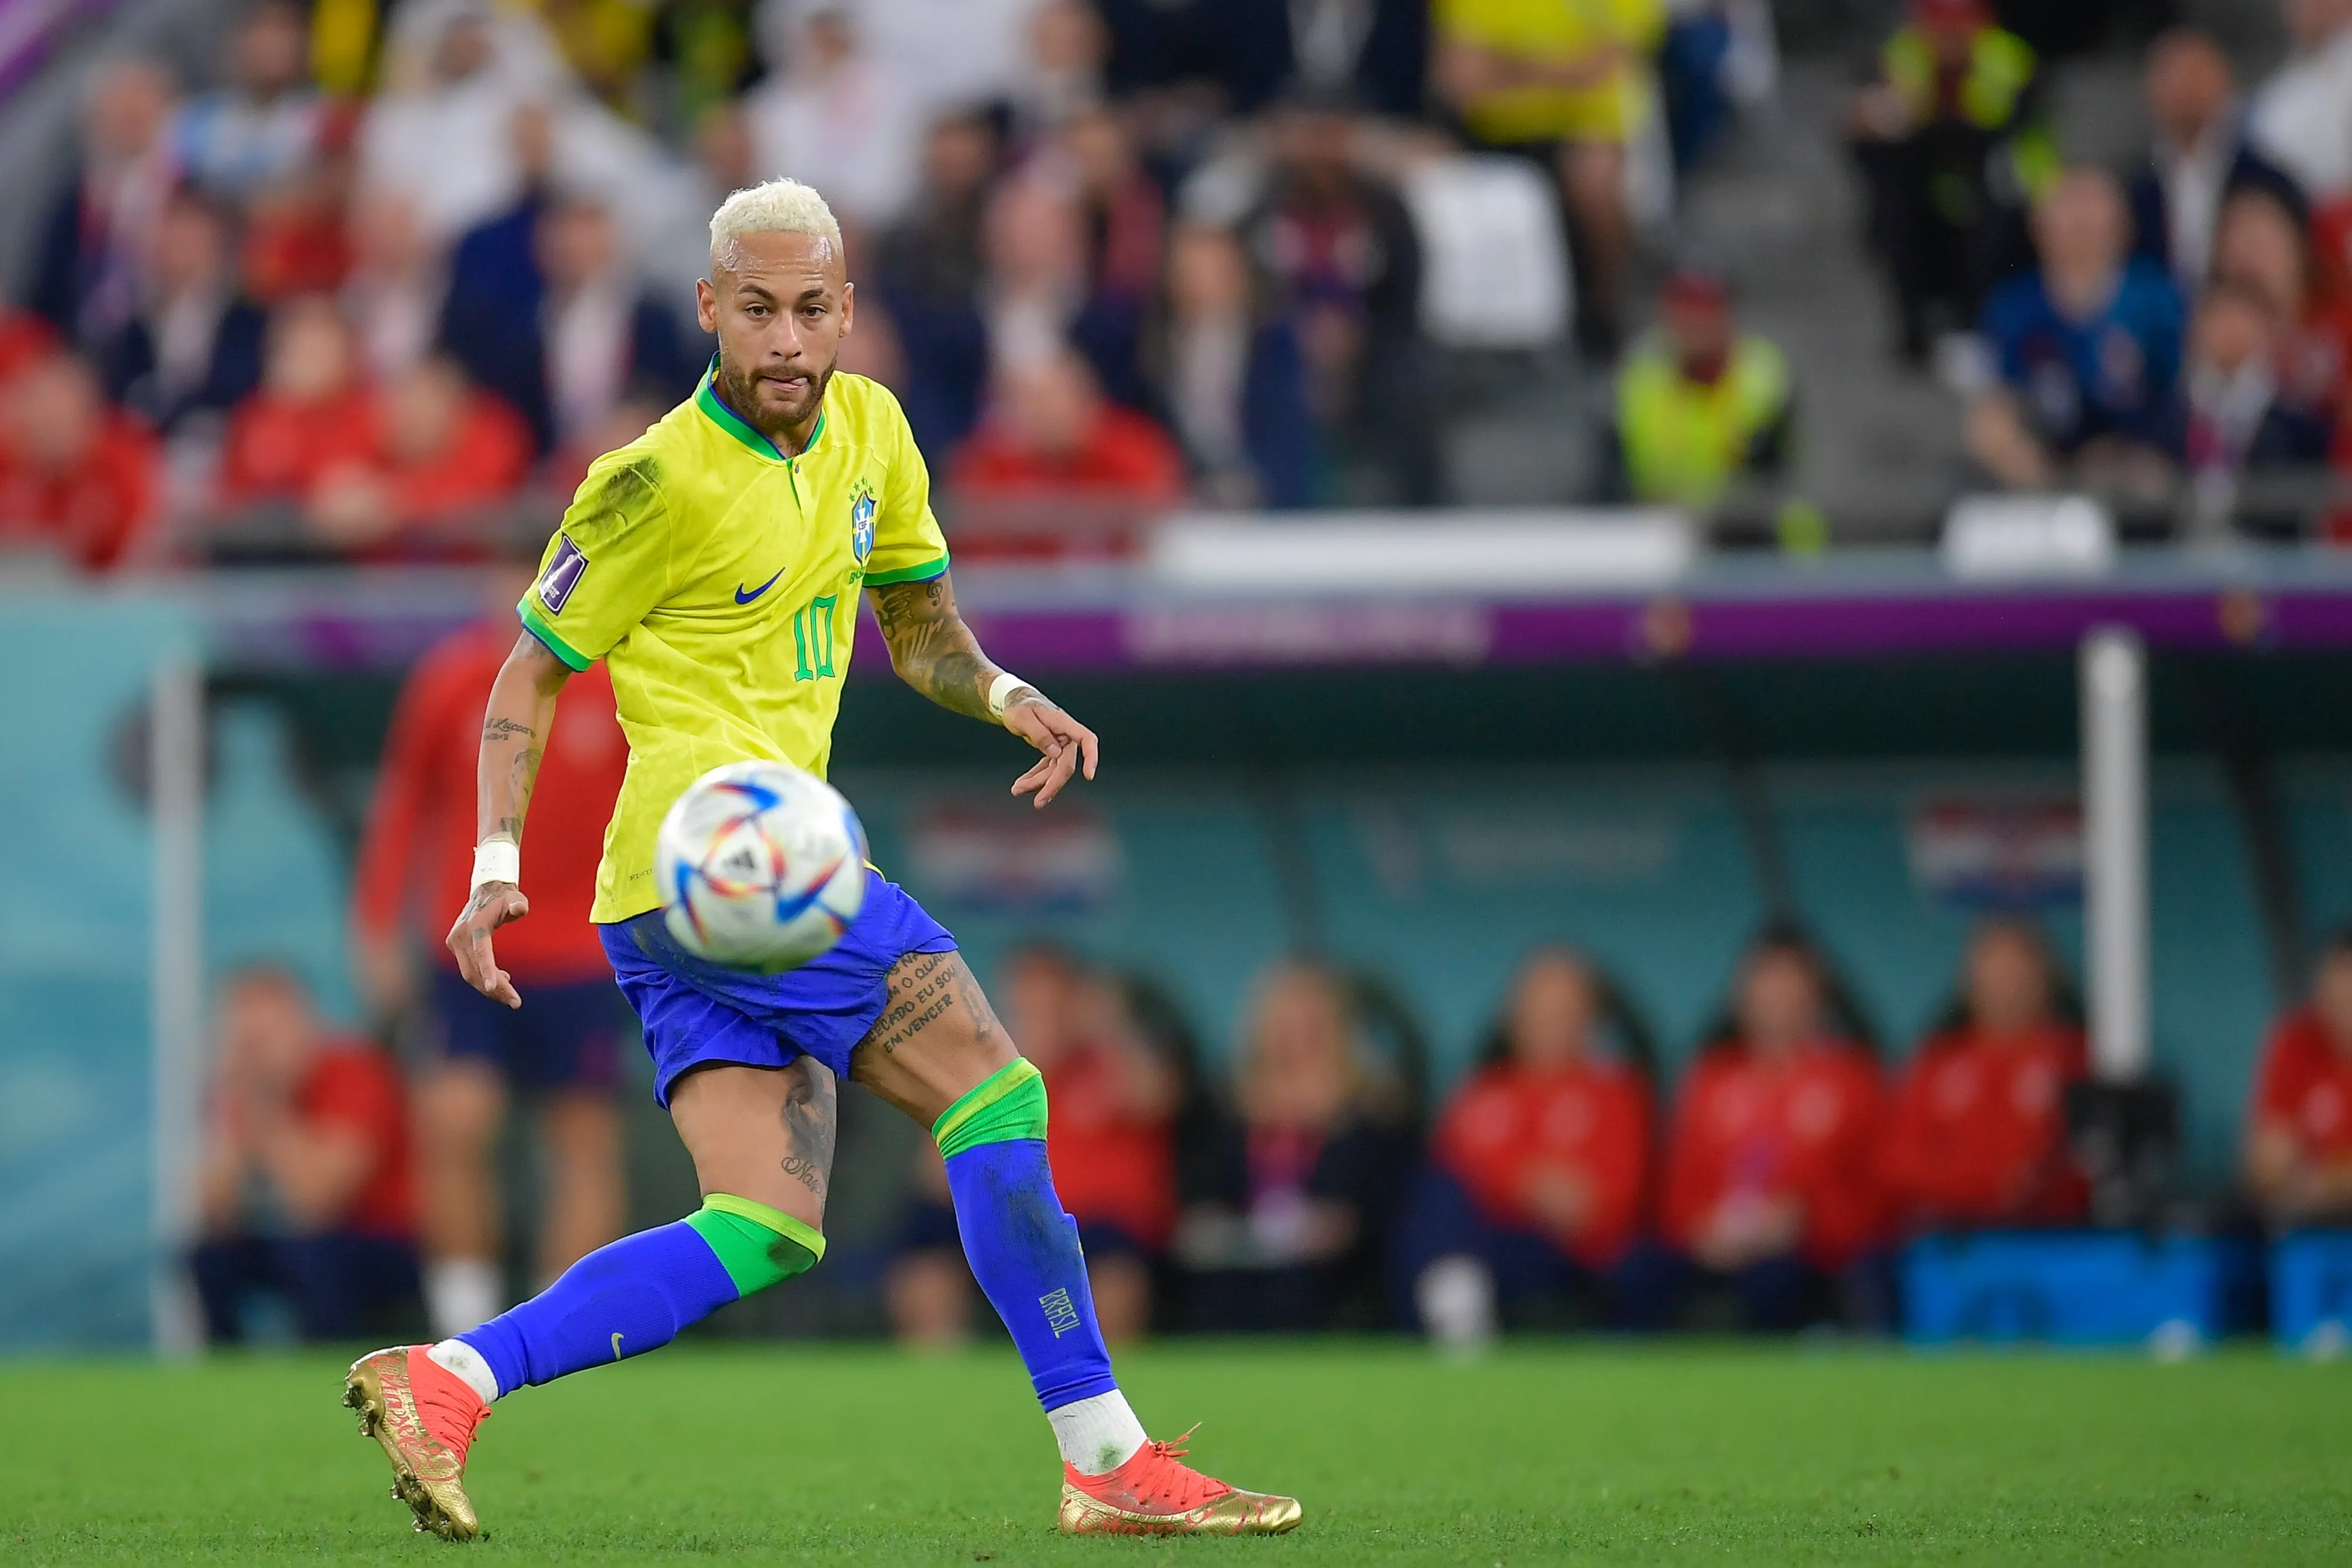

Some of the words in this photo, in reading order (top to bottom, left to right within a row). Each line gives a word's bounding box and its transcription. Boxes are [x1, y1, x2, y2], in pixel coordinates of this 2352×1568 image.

[794, 594, 838, 682] 10
[902, 977, 913, 988] O
[916, 984, 935, 1004] EU
[936, 964, 956, 989] SOU
[884, 1033, 903, 1053] EM
[902, 994, 953, 1037] VENCER
[1038, 1288, 1081, 1339] BRASIL
